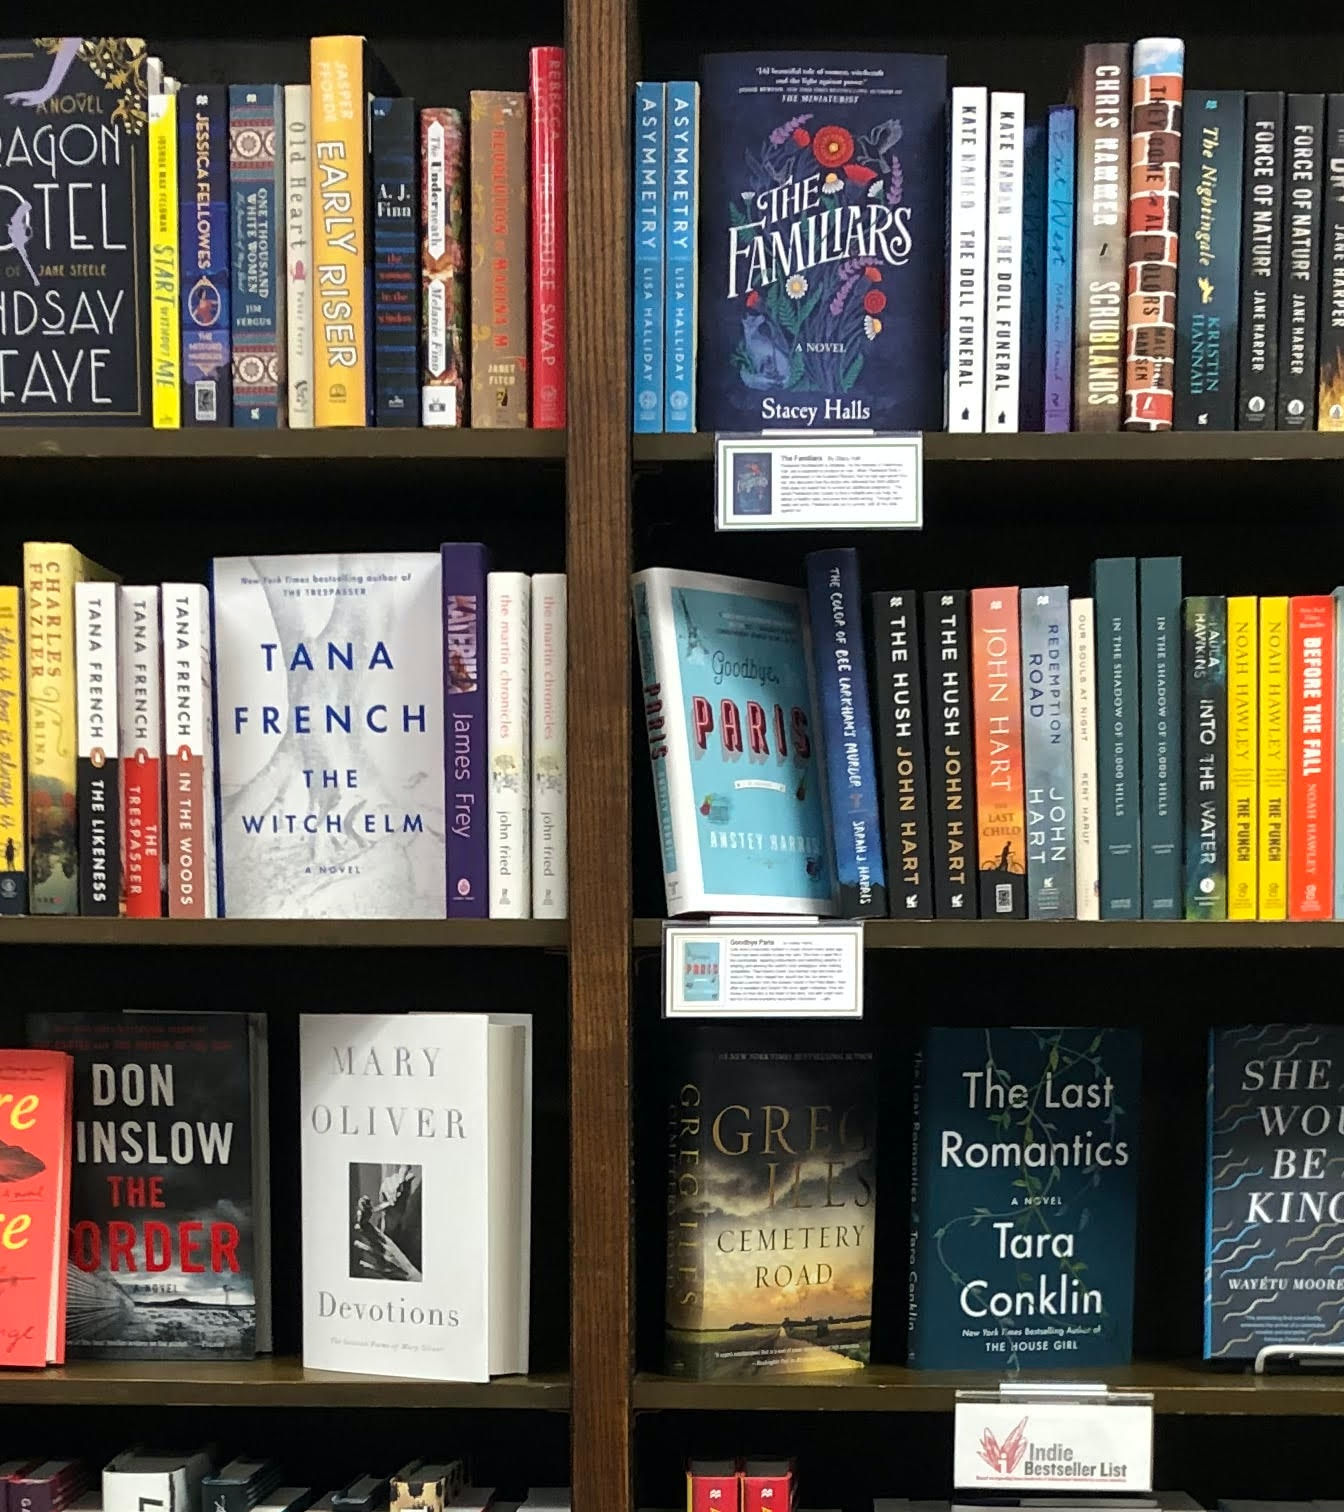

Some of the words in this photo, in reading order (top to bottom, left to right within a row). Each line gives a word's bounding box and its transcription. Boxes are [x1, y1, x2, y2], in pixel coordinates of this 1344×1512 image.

[1094, 65, 1120, 129] CHRIS
[672, 98, 690, 249] ASYMMETRY
[317, 141, 358, 255] EARLY
[757, 172, 821, 216] THE
[727, 205, 912, 298] FAMILIARS
[39, 264, 65, 277] JANE
[70, 264, 106, 276] STEELE
[318, 265, 357, 368] RISER
[1088, 280, 1120, 405] SCRUBLANDS
[0, 349, 112, 403] FAYE
[762, 398, 817, 422] Stacey
[824, 399, 871, 420] Halls
[940, 613, 958, 661] THE
[261, 641, 394, 671] TANA
[984, 627, 1009, 703] JOHN
[234, 704, 428, 734] FRENCH
[942, 673, 961, 737] HUSH
[454, 712, 474, 780] James
[692, 695, 812, 760] PARIS
[989, 716, 1011, 792] HART
[304, 769, 358, 789] THE
[241, 814, 345, 834] WITCH
[365, 815, 424, 834] ELM
[453, 793, 475, 838] Frey
[329, 1046, 442, 1078] MARY
[1241, 1059, 1332, 1092] SHE
[92, 1063, 174, 1107] DON
[962, 1068, 1028, 1109] The
[1045, 1070, 1114, 1108] Last
[311, 1104, 467, 1140] OLIVER
[940, 1130, 1129, 1168] Romantics
[1270, 1148, 1327, 1179] BE
[108, 1176, 166, 1209] THE
[74, 1221, 241, 1274] ORDER
[717, 1224, 866, 1254] CEMETERY
[993, 1222, 1074, 1258] Tara
[755, 1262, 834, 1289] ROAD
[1293, 1278, 1344, 1290] MOORE
[318, 1291, 459, 1328] Devotions
[960, 1281, 1103, 1318] Conklin
[985, 1341, 1008, 1352] THE
[1011, 1341, 1051, 1352] HOUSE
[1054, 1340, 1079, 1351] GIRL
[1024, 1462, 1096, 1478] Bestseller
[1101, 1464, 1127, 1478] List
[1029, 1443, 1073, 1461] Indie
